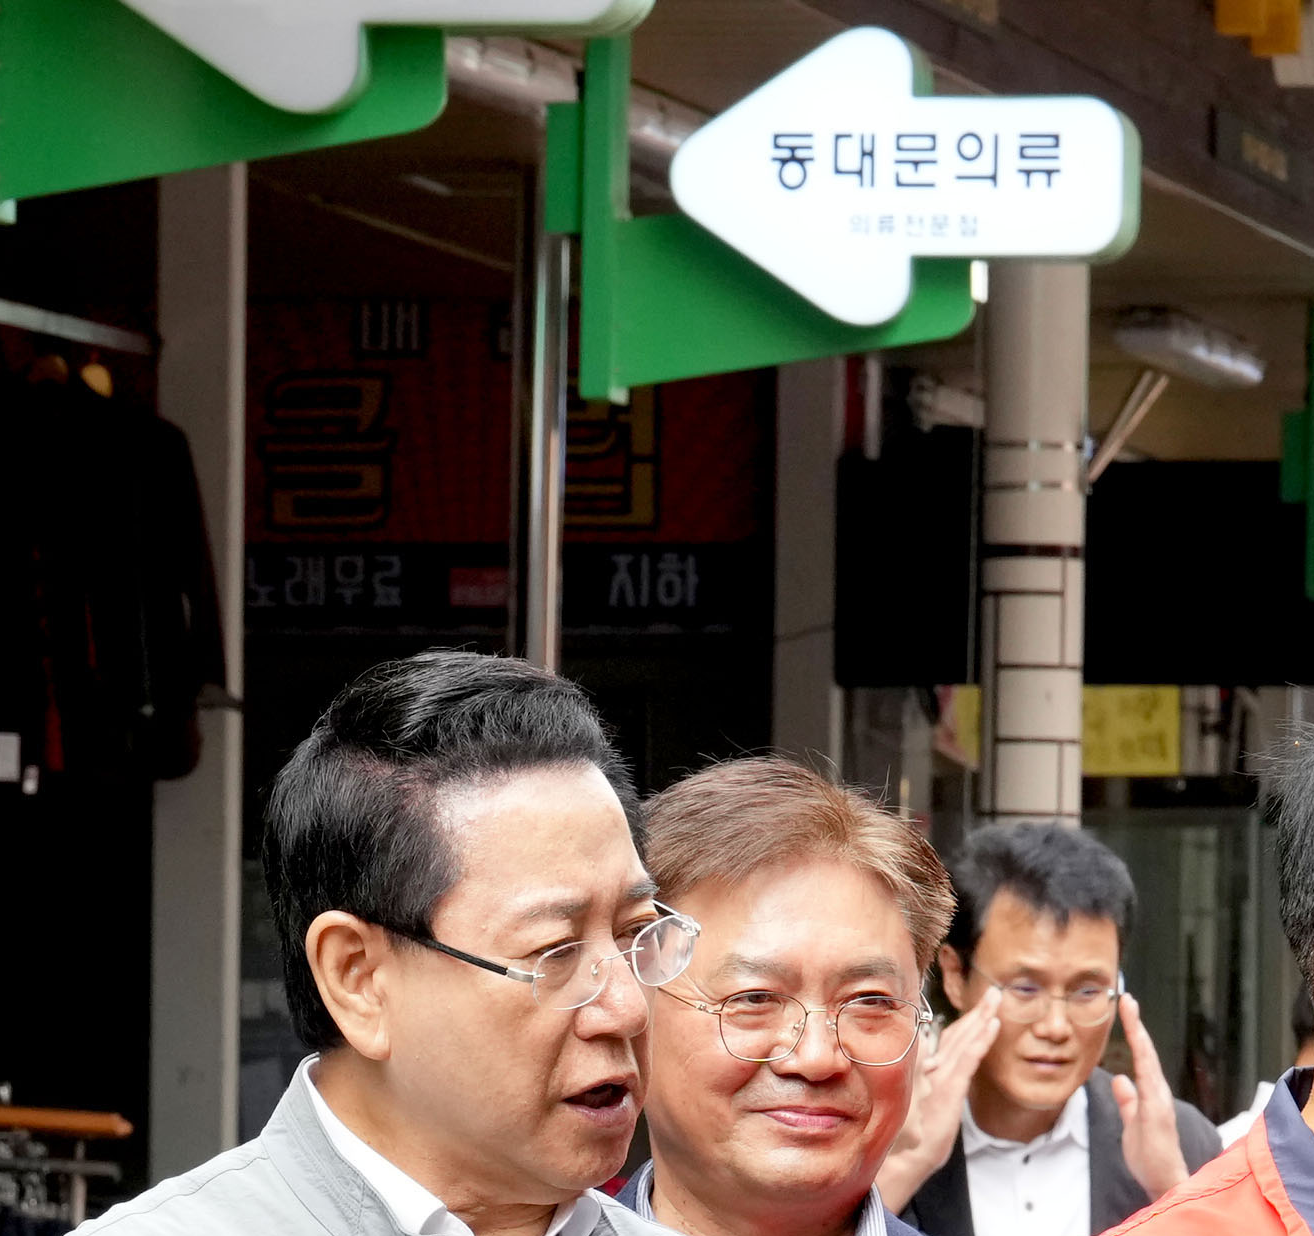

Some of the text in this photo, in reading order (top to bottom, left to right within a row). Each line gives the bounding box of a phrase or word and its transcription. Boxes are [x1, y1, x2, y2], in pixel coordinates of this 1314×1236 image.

[771, 131, 1062, 191] 동대문의류
[848, 213, 980, 239] 의류전문점
[607, 551, 701, 609] 지하
